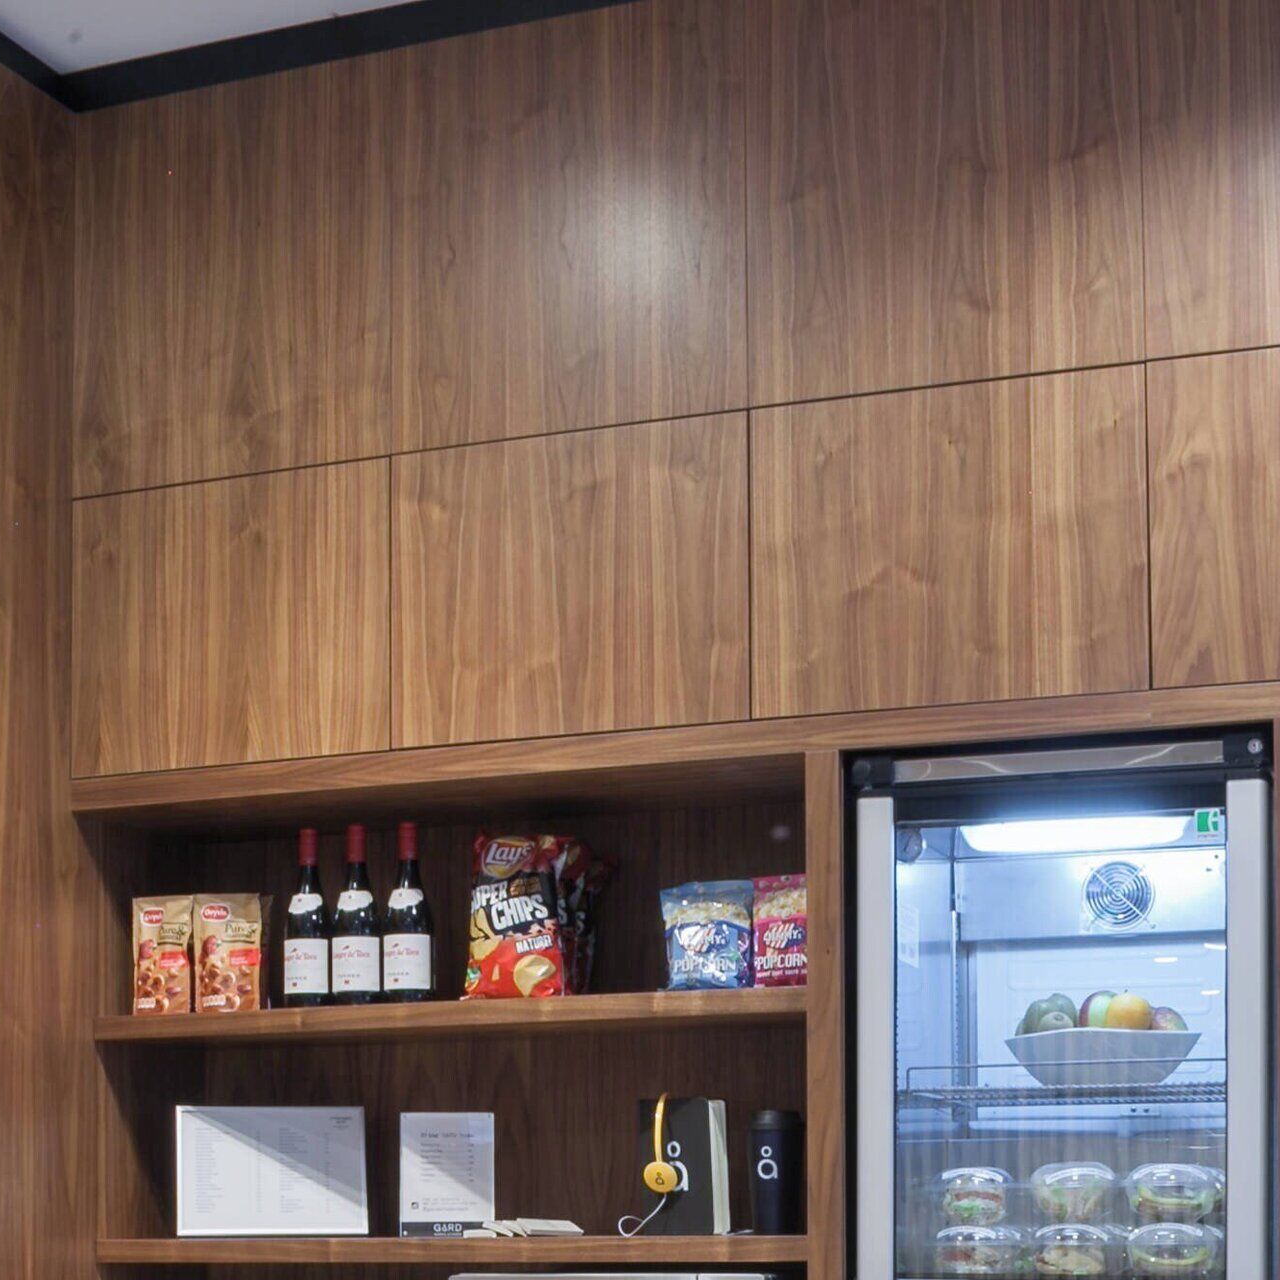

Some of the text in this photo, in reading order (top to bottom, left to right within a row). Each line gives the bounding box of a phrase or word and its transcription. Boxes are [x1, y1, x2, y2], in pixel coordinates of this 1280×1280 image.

[472, 881, 508, 911] UPER
[491, 894, 548, 931] CHIPS
[756, 953, 807, 971] POPCORN
